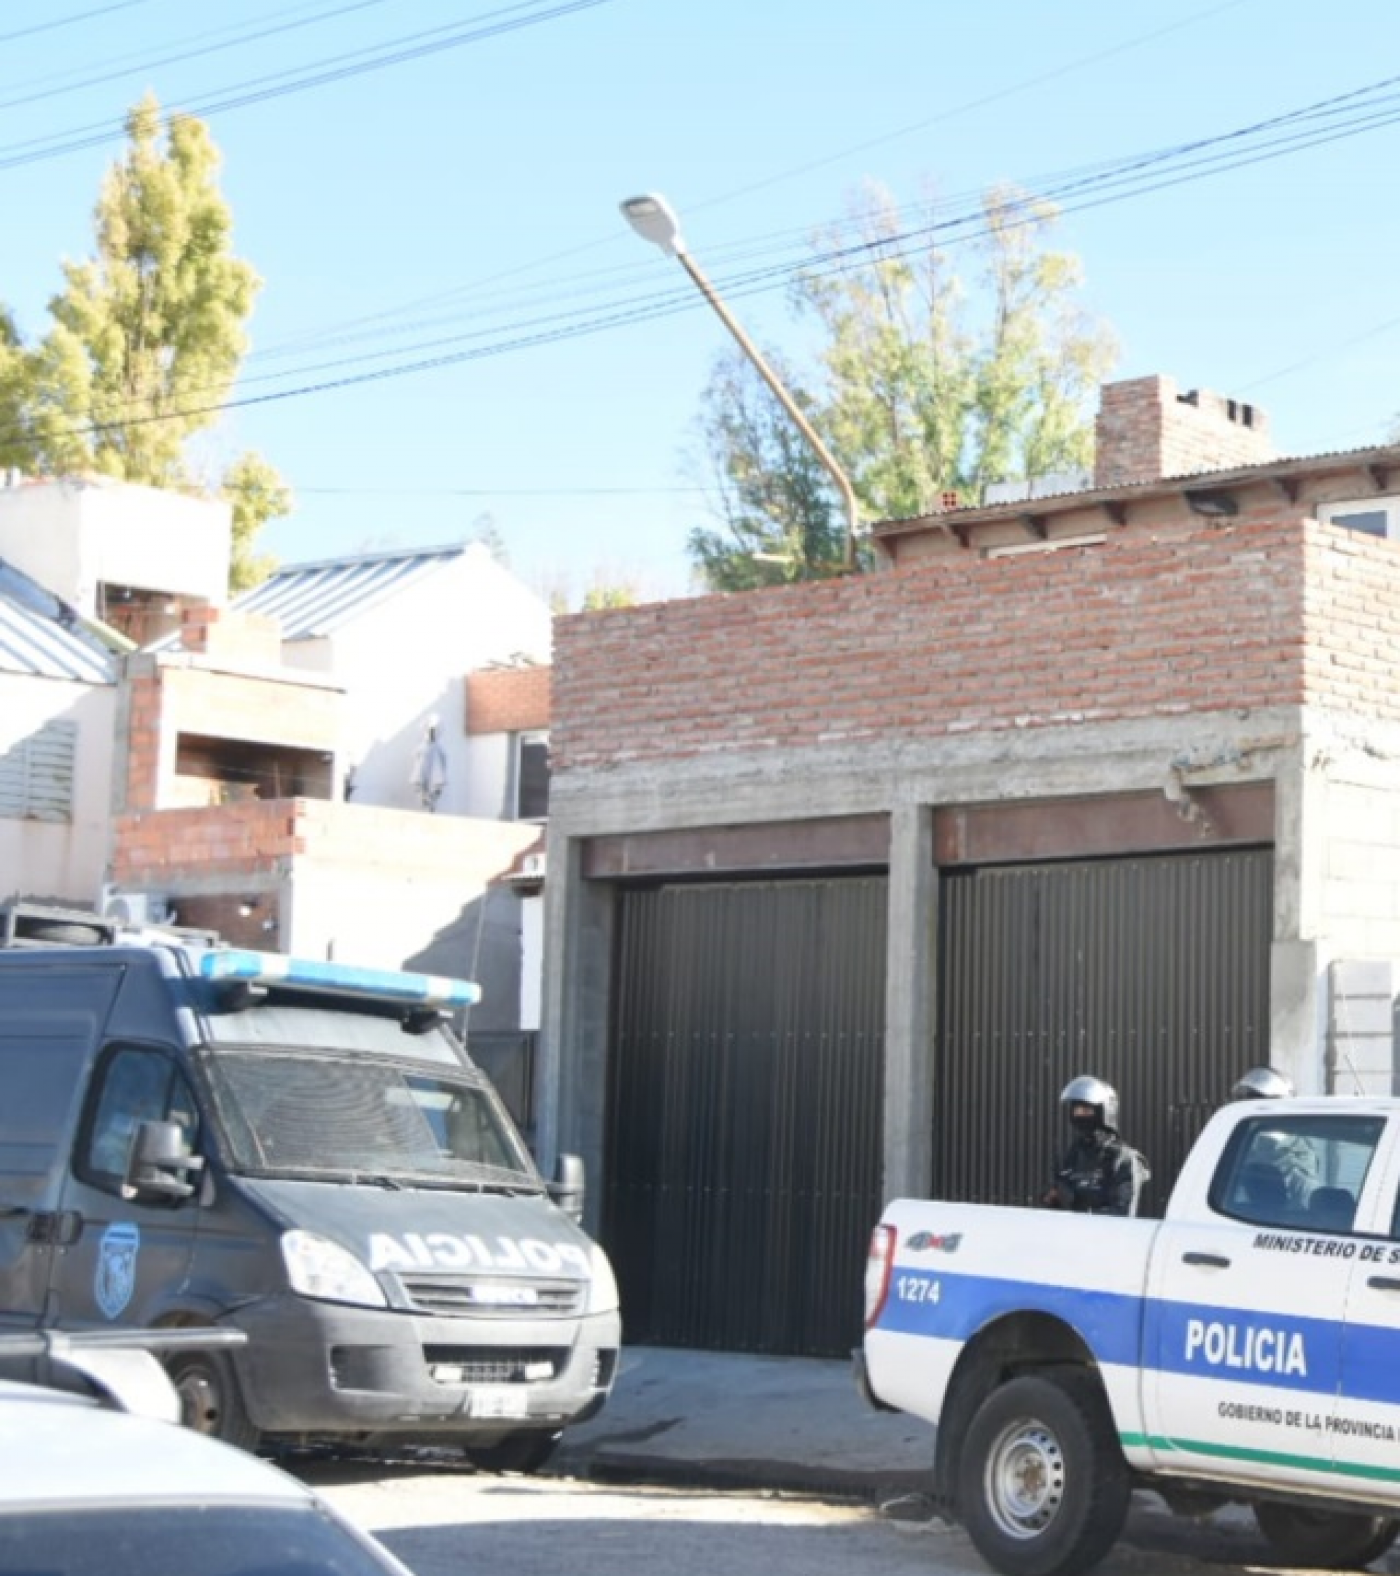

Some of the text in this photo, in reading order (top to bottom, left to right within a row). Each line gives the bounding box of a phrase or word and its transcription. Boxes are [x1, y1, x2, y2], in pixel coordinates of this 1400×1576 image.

[1253, 1233, 1357, 1259] MINISTERIO
[1359, 1245, 1386, 1262] DE
[897, 1275, 940, 1306] 1274
[1185, 1319, 1307, 1377] POLICIA
[1218, 1401, 1282, 1425] GOBIERNO
[1285, 1411, 1302, 1427] DE
[1305, 1413, 1321, 1430] LA
[1325, 1416, 1394, 1441] PROVINCIA
